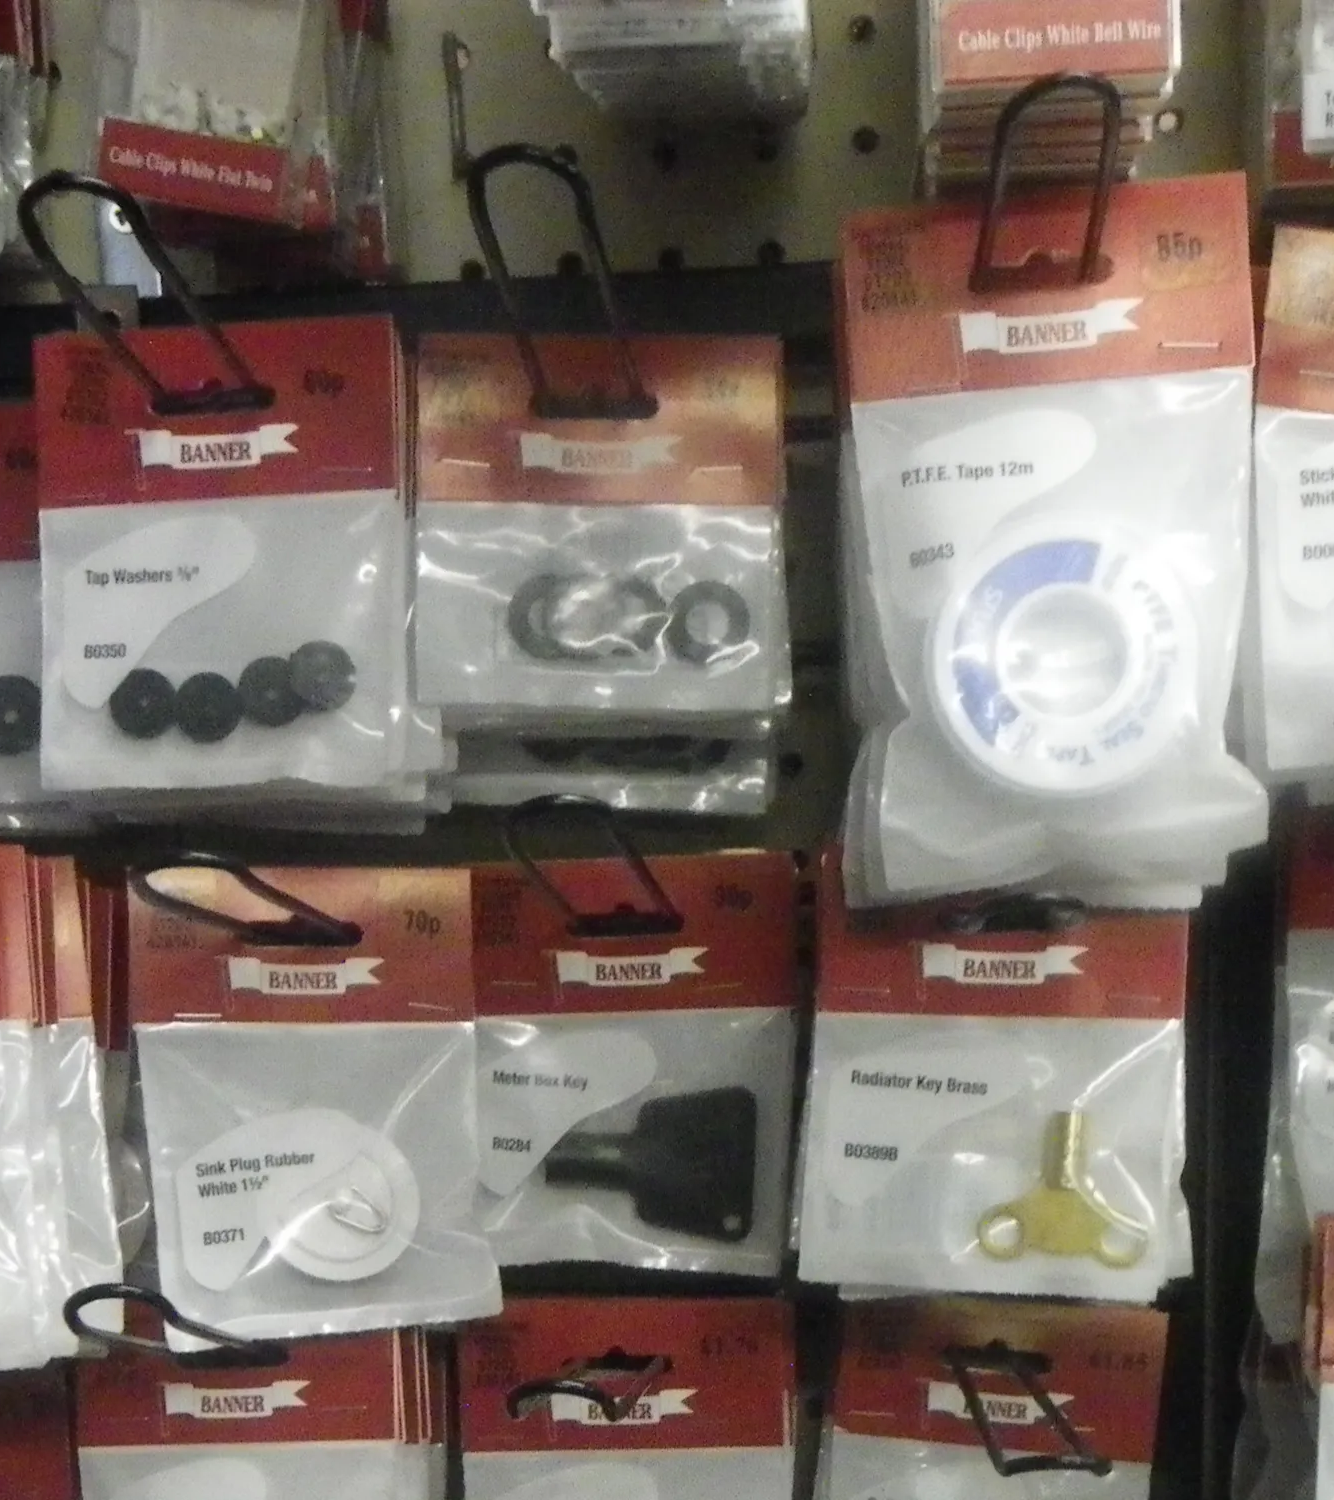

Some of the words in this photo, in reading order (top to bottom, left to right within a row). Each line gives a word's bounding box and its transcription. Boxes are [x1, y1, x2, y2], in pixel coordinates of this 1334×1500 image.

[958, 28, 1000, 53] Cable
[1004, 26, 1044, 52] Clips
[1047, 24, 1089, 47] White
[1094, 22, 1123, 43] Bell
[1126, 20, 1161, 41] Wire
[108, 145, 144, 168] Cable
[1007, 320, 1088, 347] BANNER
[179, 440, 252, 464] BANNER
[901, 465, 951, 489] P.T.F.E.
[956, 463, 994, 483] Tape
[999, 459, 1034, 477] 12m
[85, 569, 109, 588] Tap
[112, 568, 174, 585] Washers
[84, 643, 127, 660] B0350
[403, 908, 442, 939] 70p
[268, 971, 338, 991] BANNER
[595, 963, 663, 981] BANNER
[962, 960, 1036, 980] BANNER
[492, 1069, 529, 1084] Meter
[563, 1073, 588, 1092] Key
[851, 1069, 913, 1092] Radiator
[916, 1074, 943, 1095] Key
[945, 1076, 988, 1096] Brass
[195, 1160, 227, 1179] Sink
[230, 1157, 263, 1178] Plug
[265, 1150, 315, 1171] Rubber
[197, 1180, 238, 1199] White
[203, 1228, 246, 1246] B0371
[199, 1393, 265, 1413] BANNER
